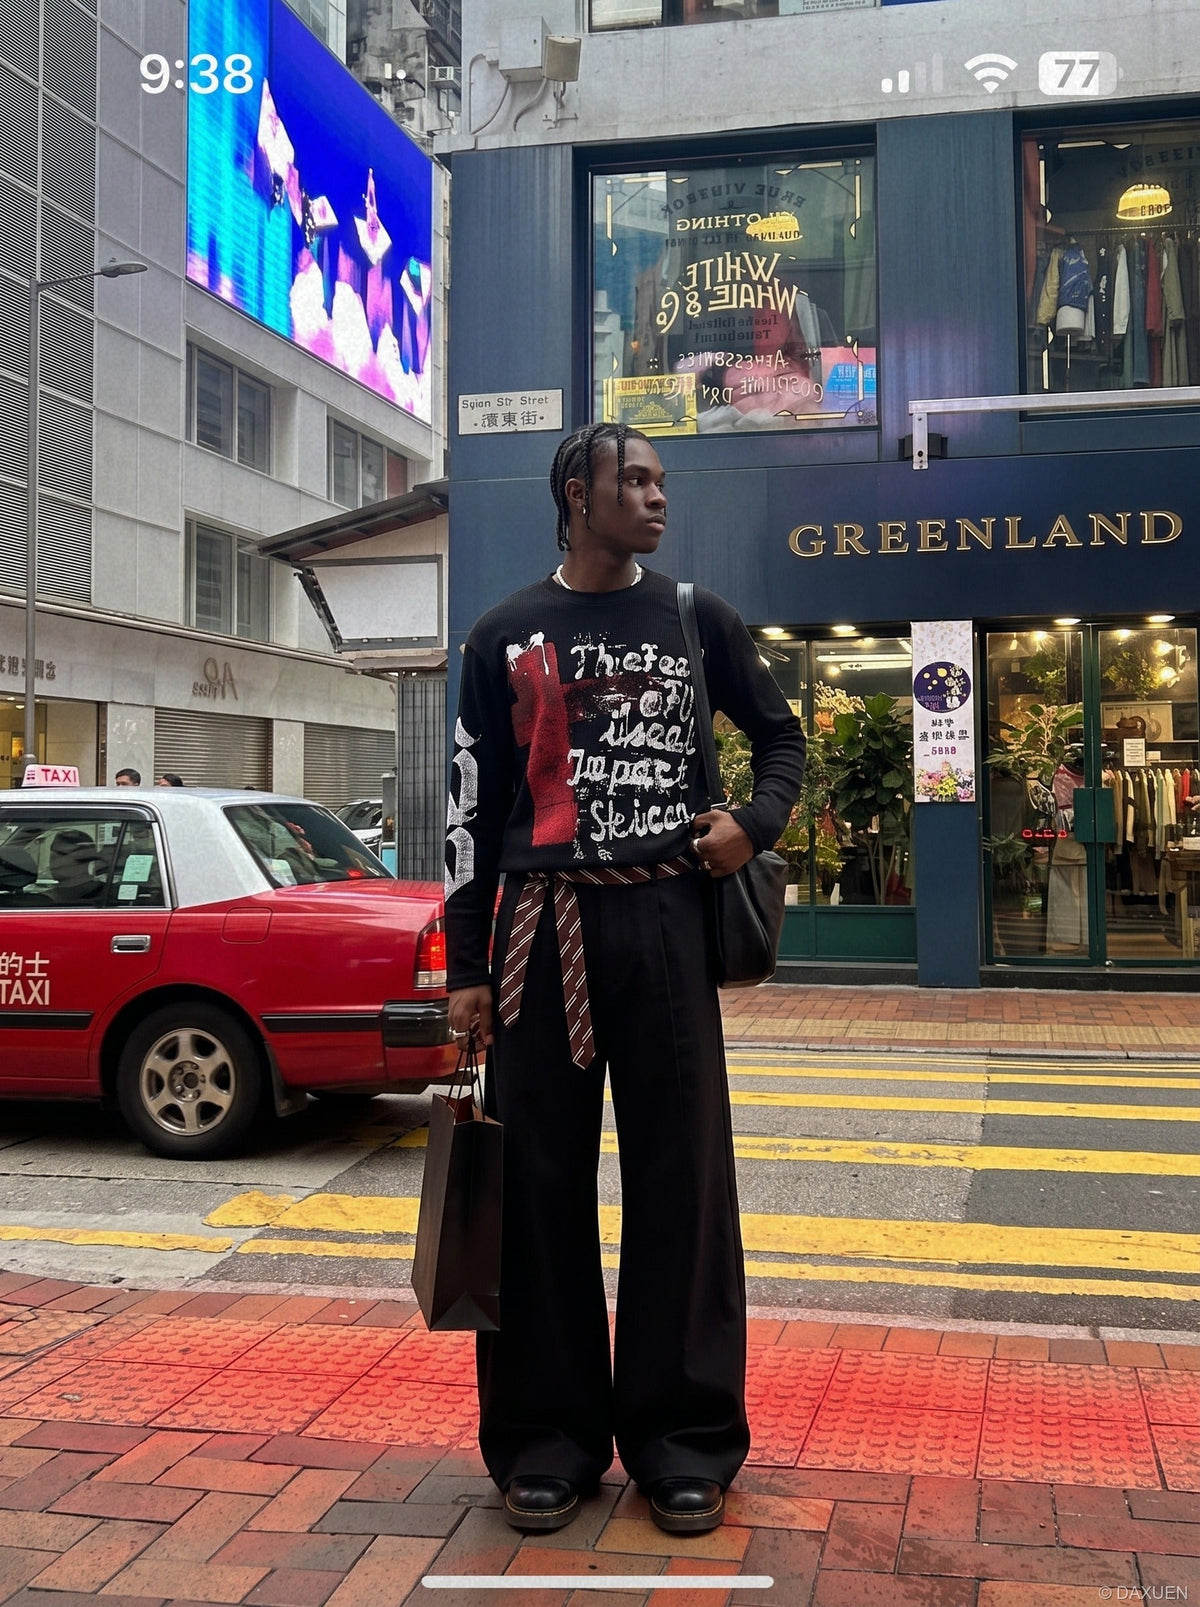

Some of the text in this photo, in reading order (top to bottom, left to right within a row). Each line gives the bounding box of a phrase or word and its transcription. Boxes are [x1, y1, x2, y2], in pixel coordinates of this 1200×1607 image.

[788, 511, 1184, 558] GREENLAND
[41, 769, 77, 783] TAXI
[0, 951, 50, 977] 的士
[0, 979, 50, 1006] TAXI
